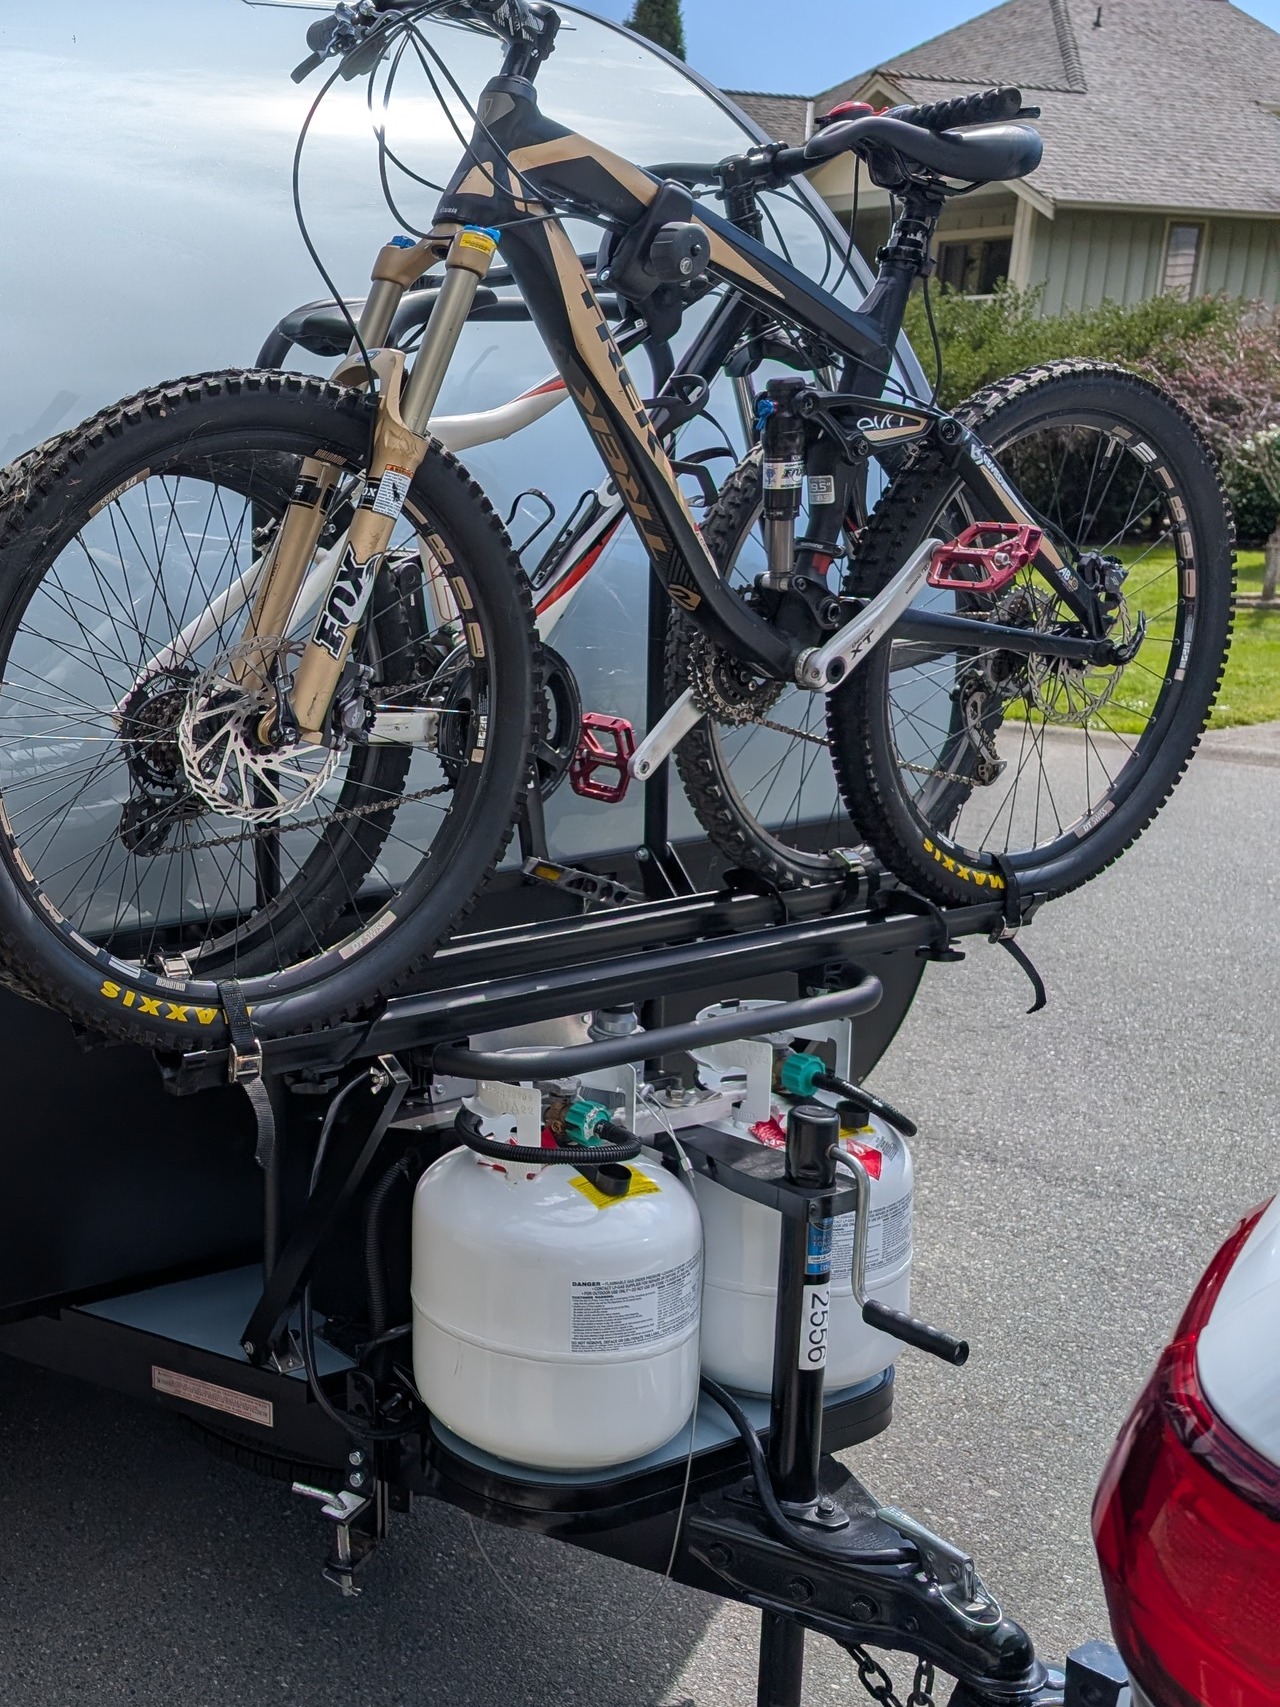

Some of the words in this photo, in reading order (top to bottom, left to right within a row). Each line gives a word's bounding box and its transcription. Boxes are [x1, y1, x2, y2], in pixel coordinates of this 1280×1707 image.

[580, 273, 663, 458] TREK
[100, 485, 123, 507] SWISS
[122, 476, 137, 490] DT
[572, 385, 668, 561] TREK
[312, 541, 375, 661] FOX
[851, 629, 874, 660] XT
[1081, 820, 1093, 832] DT
[1090, 807, 1109, 826] SWISS
[923, 838, 1005, 889] MAXXIS
[351, 937, 366, 952] DT
[363, 920, 387, 943] SWISS
[100, 980, 252, 1026] AXXIS
[808, 1291, 829, 1363] 2556
